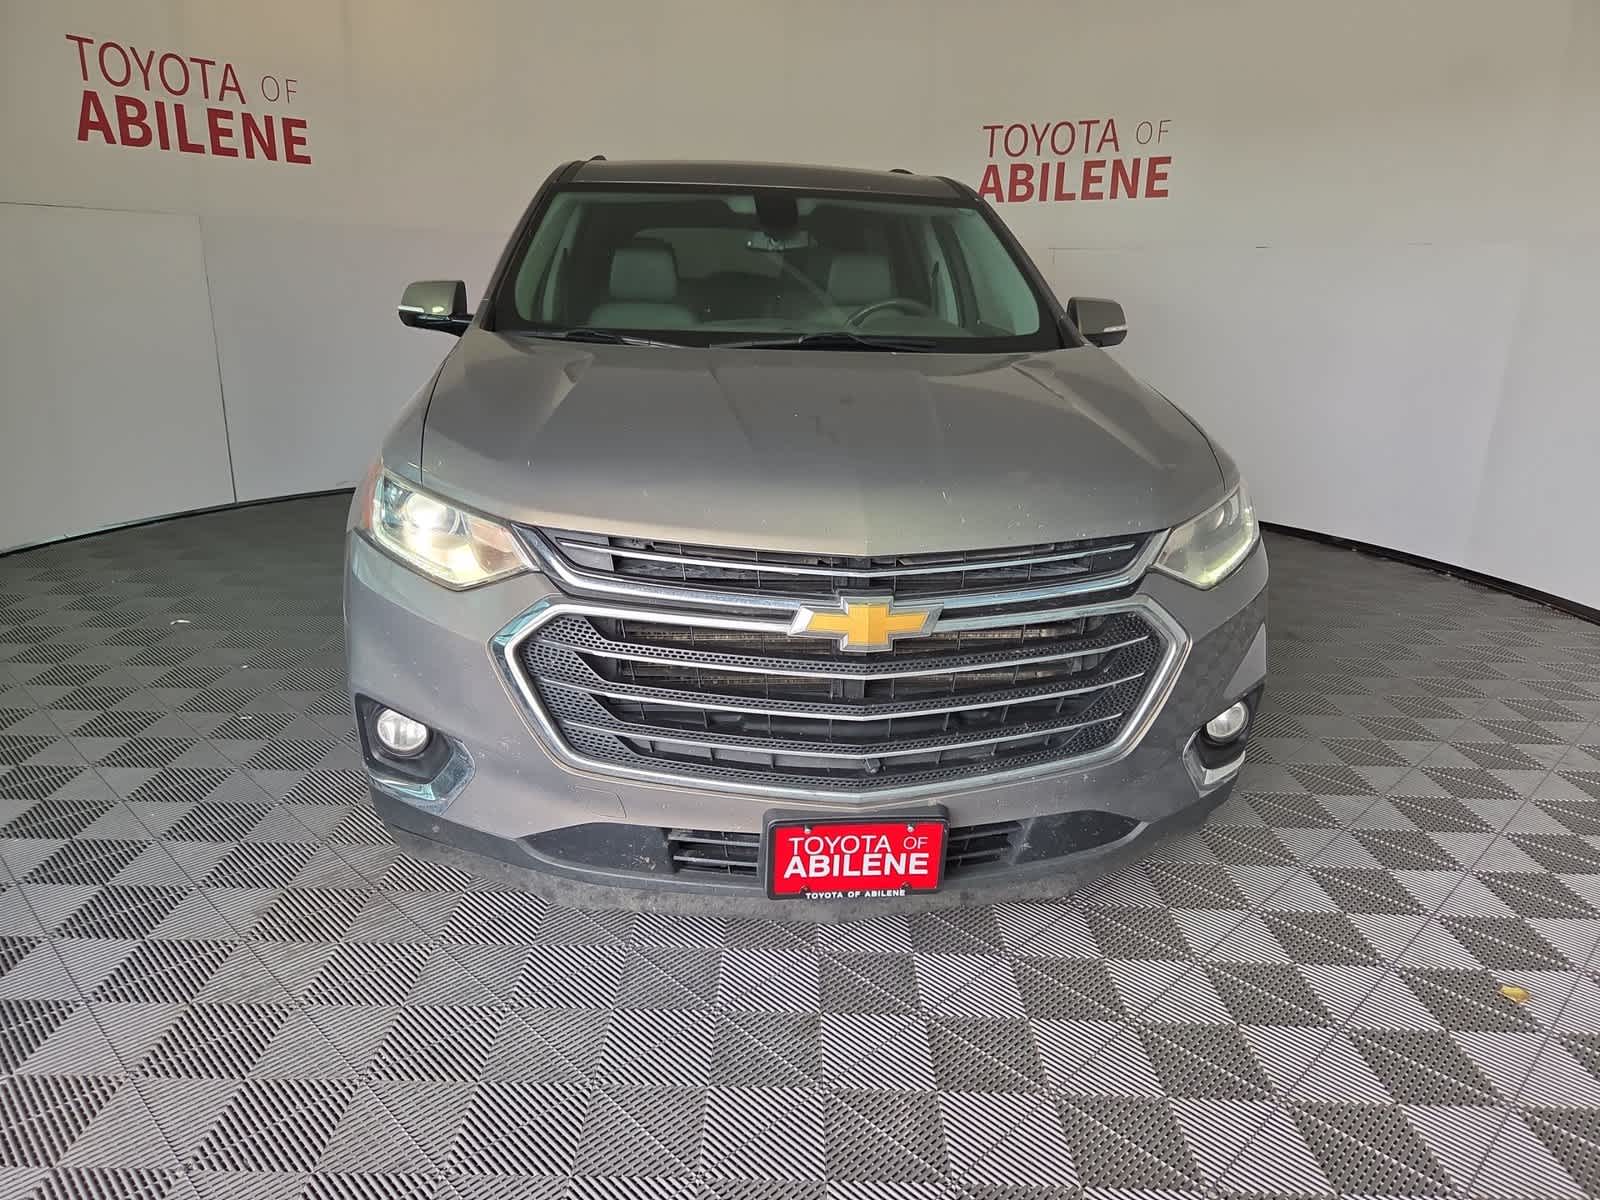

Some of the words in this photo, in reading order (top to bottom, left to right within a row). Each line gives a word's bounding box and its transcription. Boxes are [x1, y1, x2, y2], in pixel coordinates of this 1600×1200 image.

[65, 33, 247, 105] TOYOTA
[261, 75, 297, 104] OF
[77, 90, 312, 165] ABILENE
[983, 118, 1120, 158] TOYOTA
[1135, 119, 1172, 145] OF
[978, 156, 1172, 203] ABILENE
[788, 834, 892, 856] TOYOTA
[903, 836, 929, 850] OF
[783, 852, 930, 879] ABILENE
[805, 891, 844, 900] TOYOTA
[847, 890, 861, 899] OF
[864, 889, 906, 898] ABILENE
